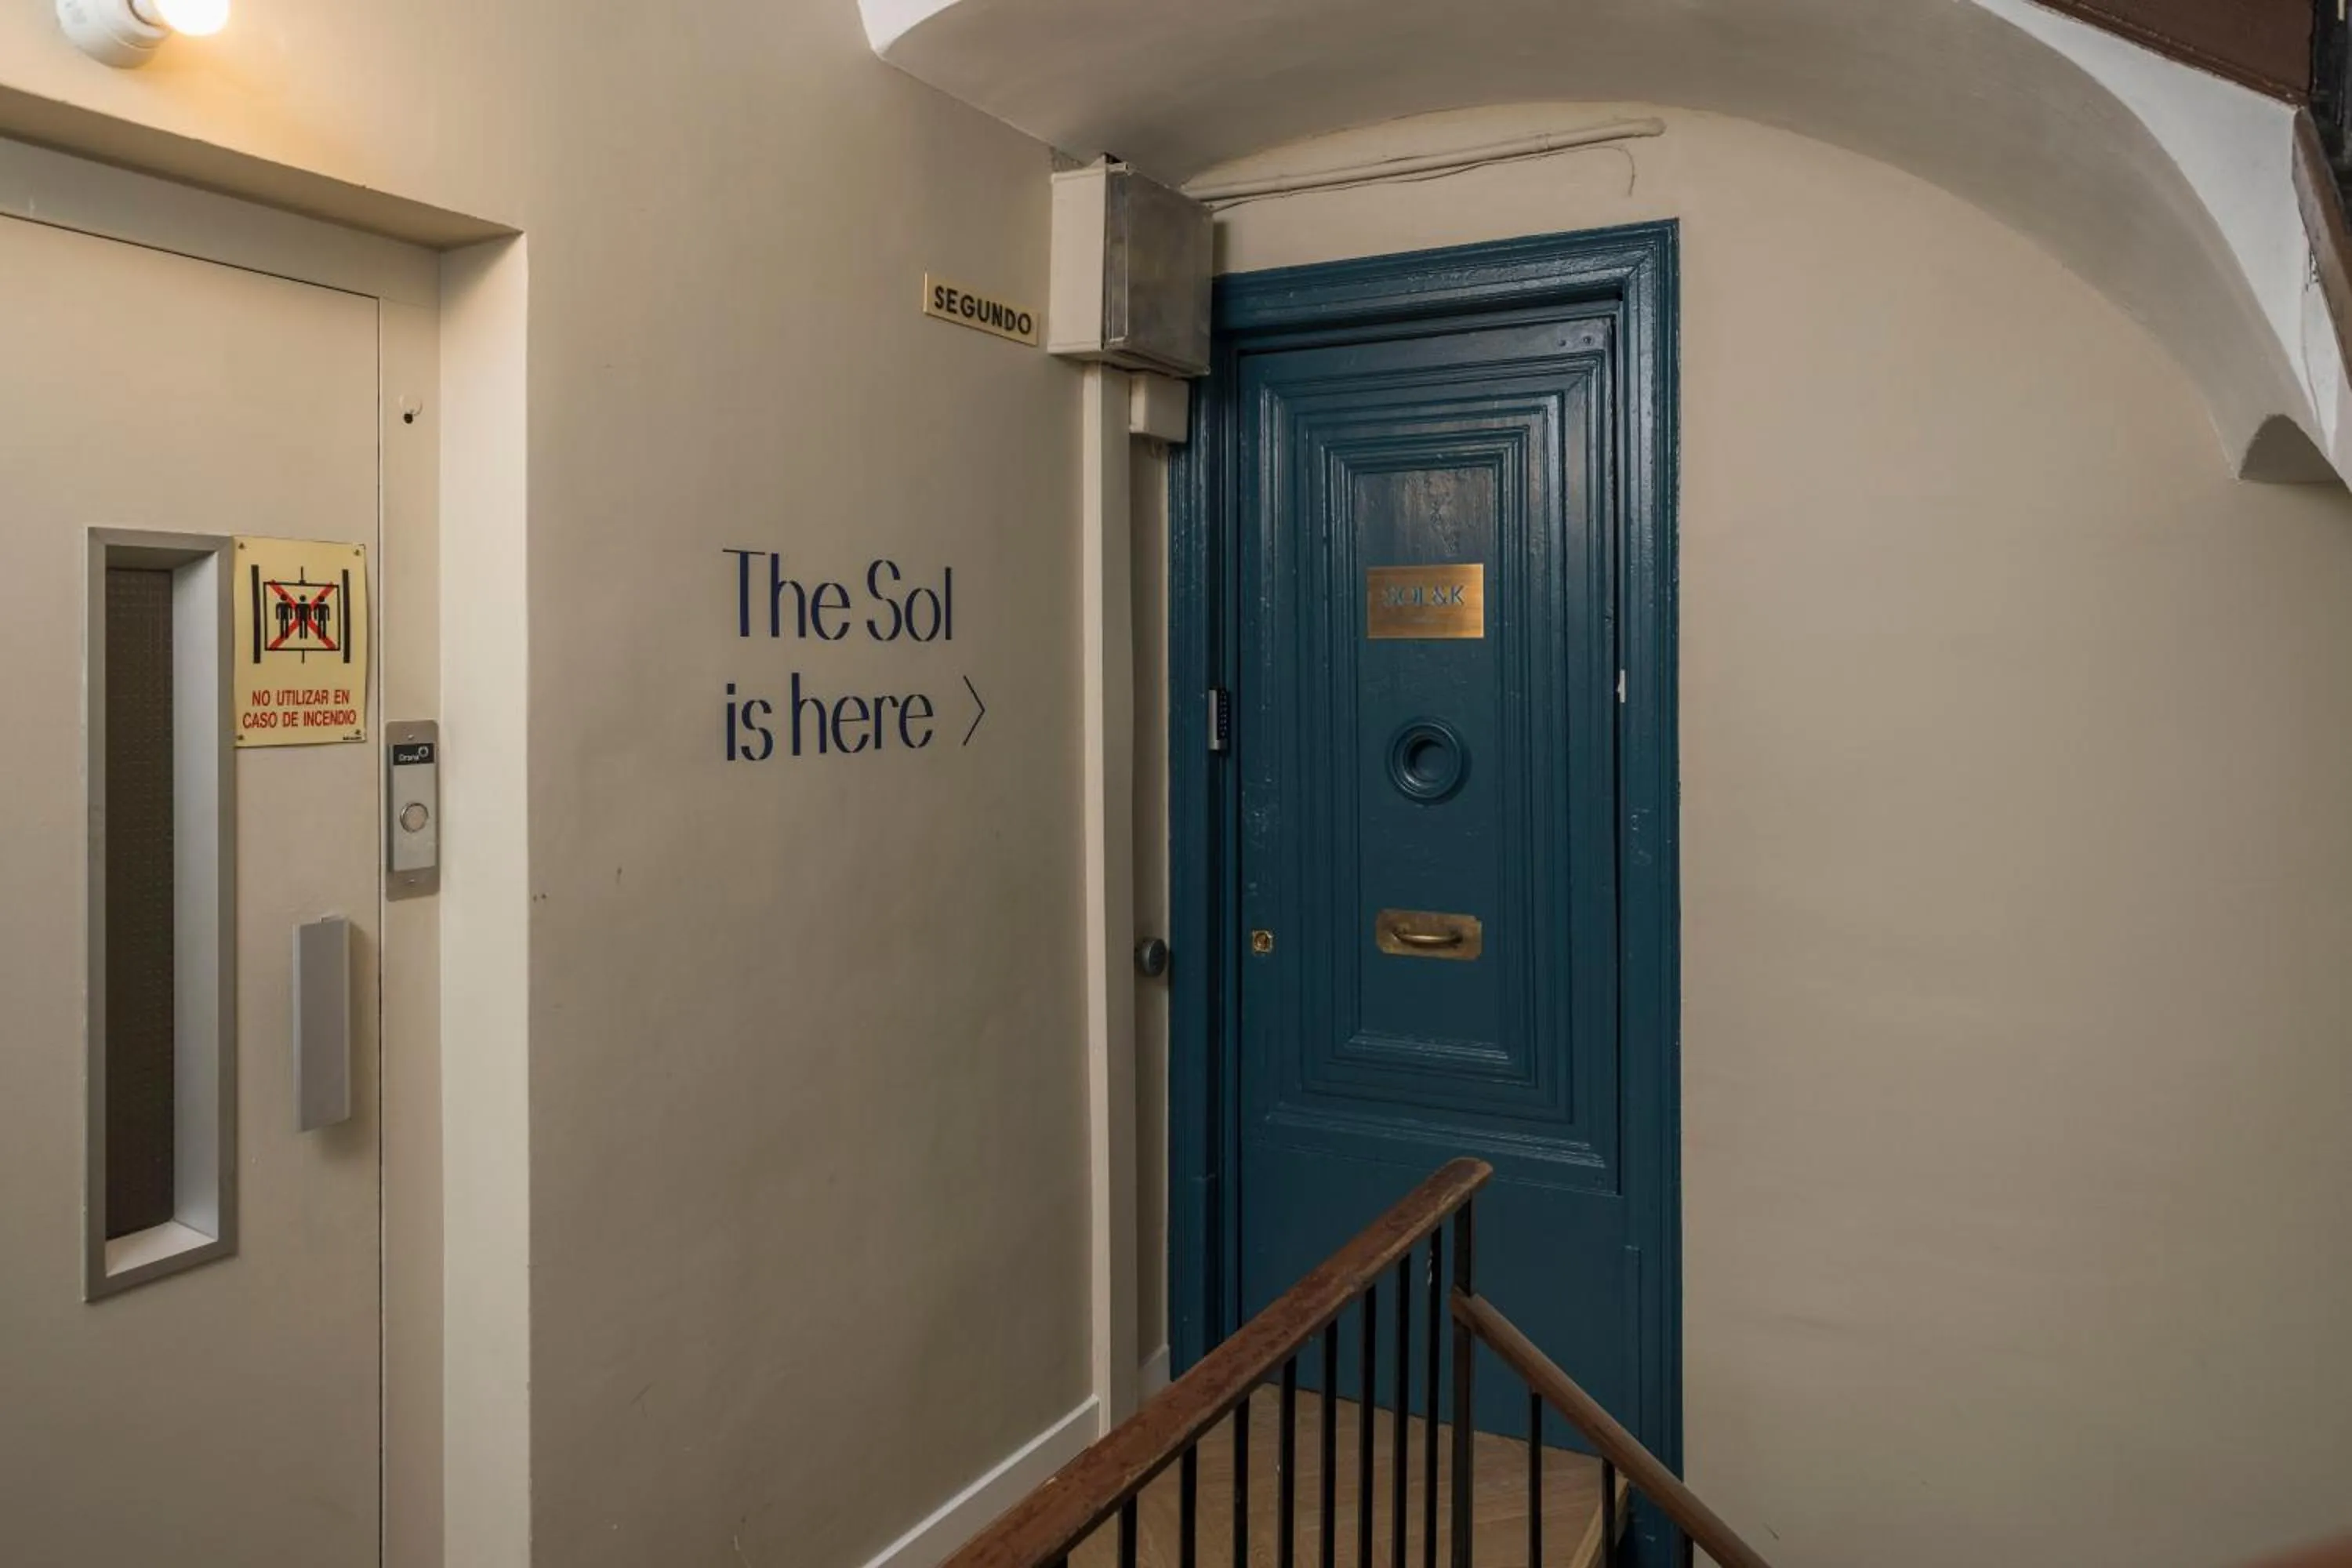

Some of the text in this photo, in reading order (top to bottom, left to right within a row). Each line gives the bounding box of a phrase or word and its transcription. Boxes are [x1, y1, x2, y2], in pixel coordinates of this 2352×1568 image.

[934, 285, 1032, 336] SEGUNDO
[722, 548, 952, 642] The Sol
[242, 710, 356, 729] CASO DE INCENDIO
[252, 689, 350, 706] NO UTILIZAR EN
[726, 672, 934, 761] is here
